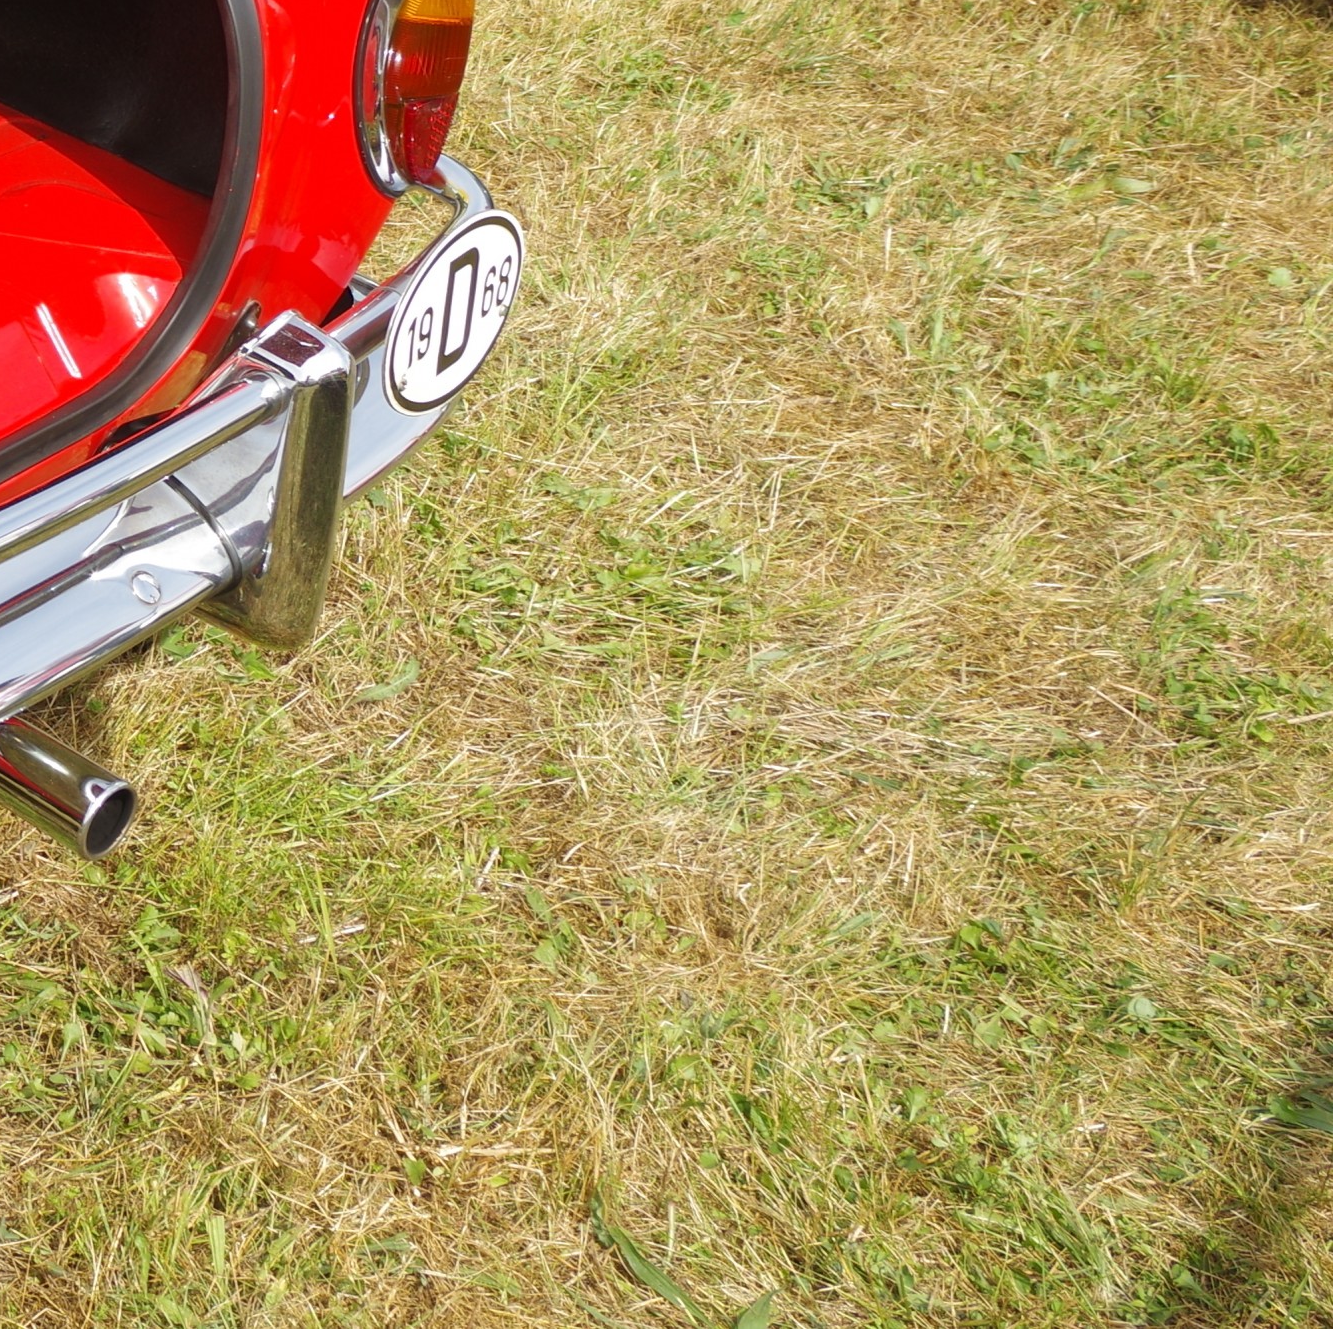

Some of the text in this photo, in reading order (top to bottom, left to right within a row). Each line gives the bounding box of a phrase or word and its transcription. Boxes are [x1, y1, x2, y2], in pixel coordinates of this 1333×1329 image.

[408, 247, 513, 377] 19 D 68
